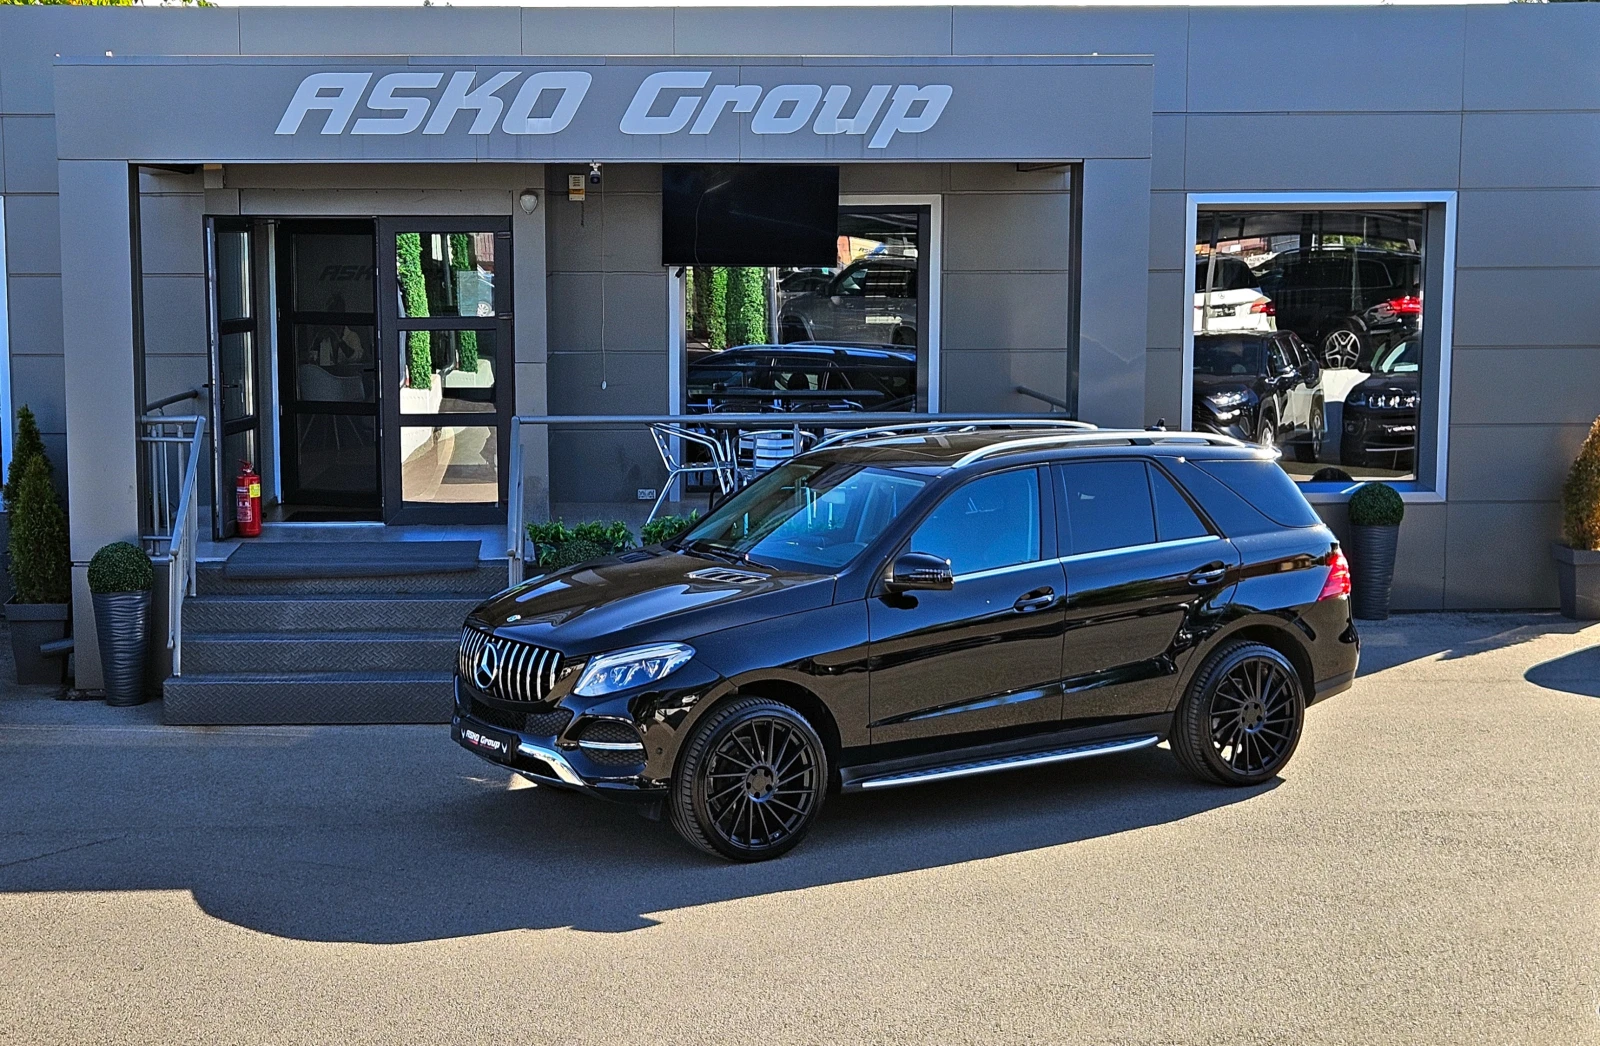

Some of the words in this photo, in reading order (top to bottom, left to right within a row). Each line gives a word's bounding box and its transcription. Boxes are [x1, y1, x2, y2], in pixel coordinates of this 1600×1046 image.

[274, 71, 593, 135] ASKO
[619, 71, 953, 149] Group
[466, 729, 480, 742] ASKO
[480, 735, 501, 749] Group
